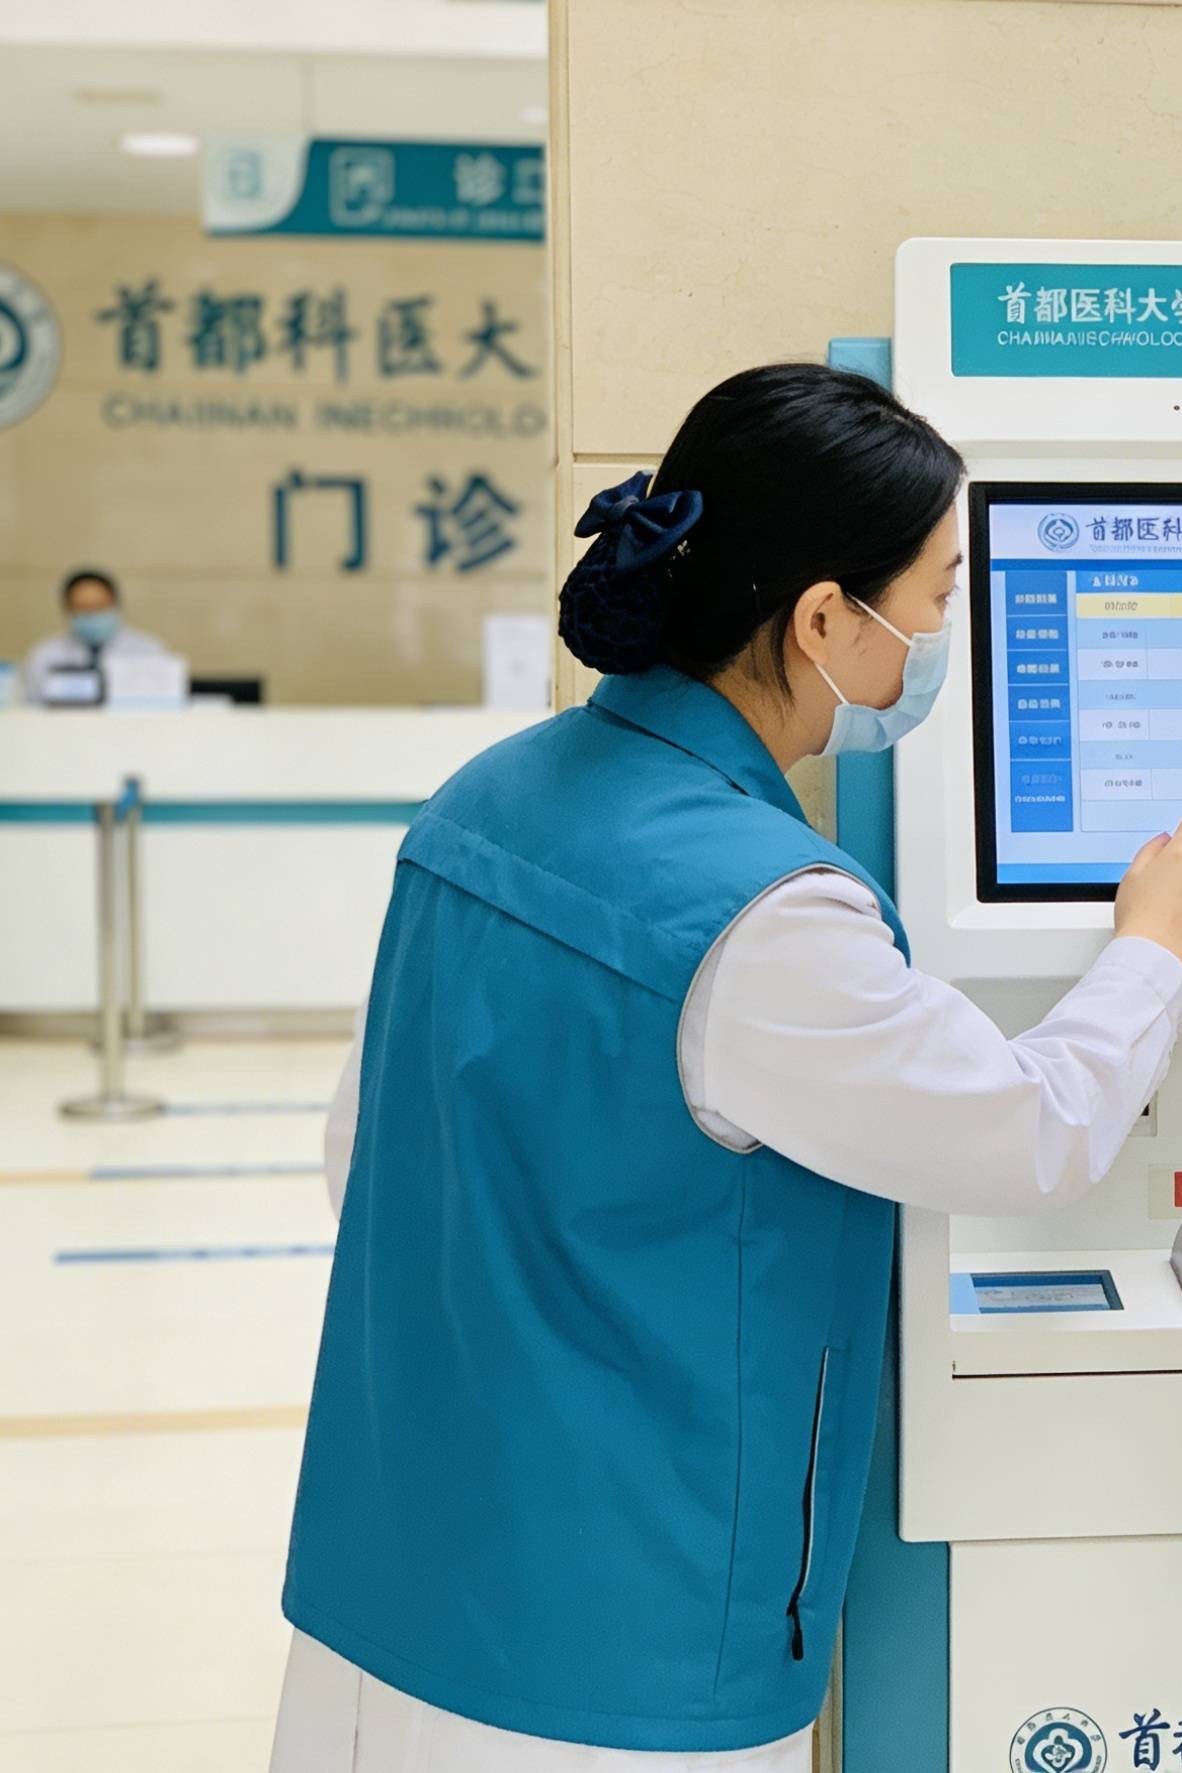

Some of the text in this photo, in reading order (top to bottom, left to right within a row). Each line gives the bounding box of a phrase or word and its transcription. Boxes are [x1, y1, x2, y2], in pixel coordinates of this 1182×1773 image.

[96, 278, 538, 382] 首都科医大
[271, 467, 520, 573] 门诊
